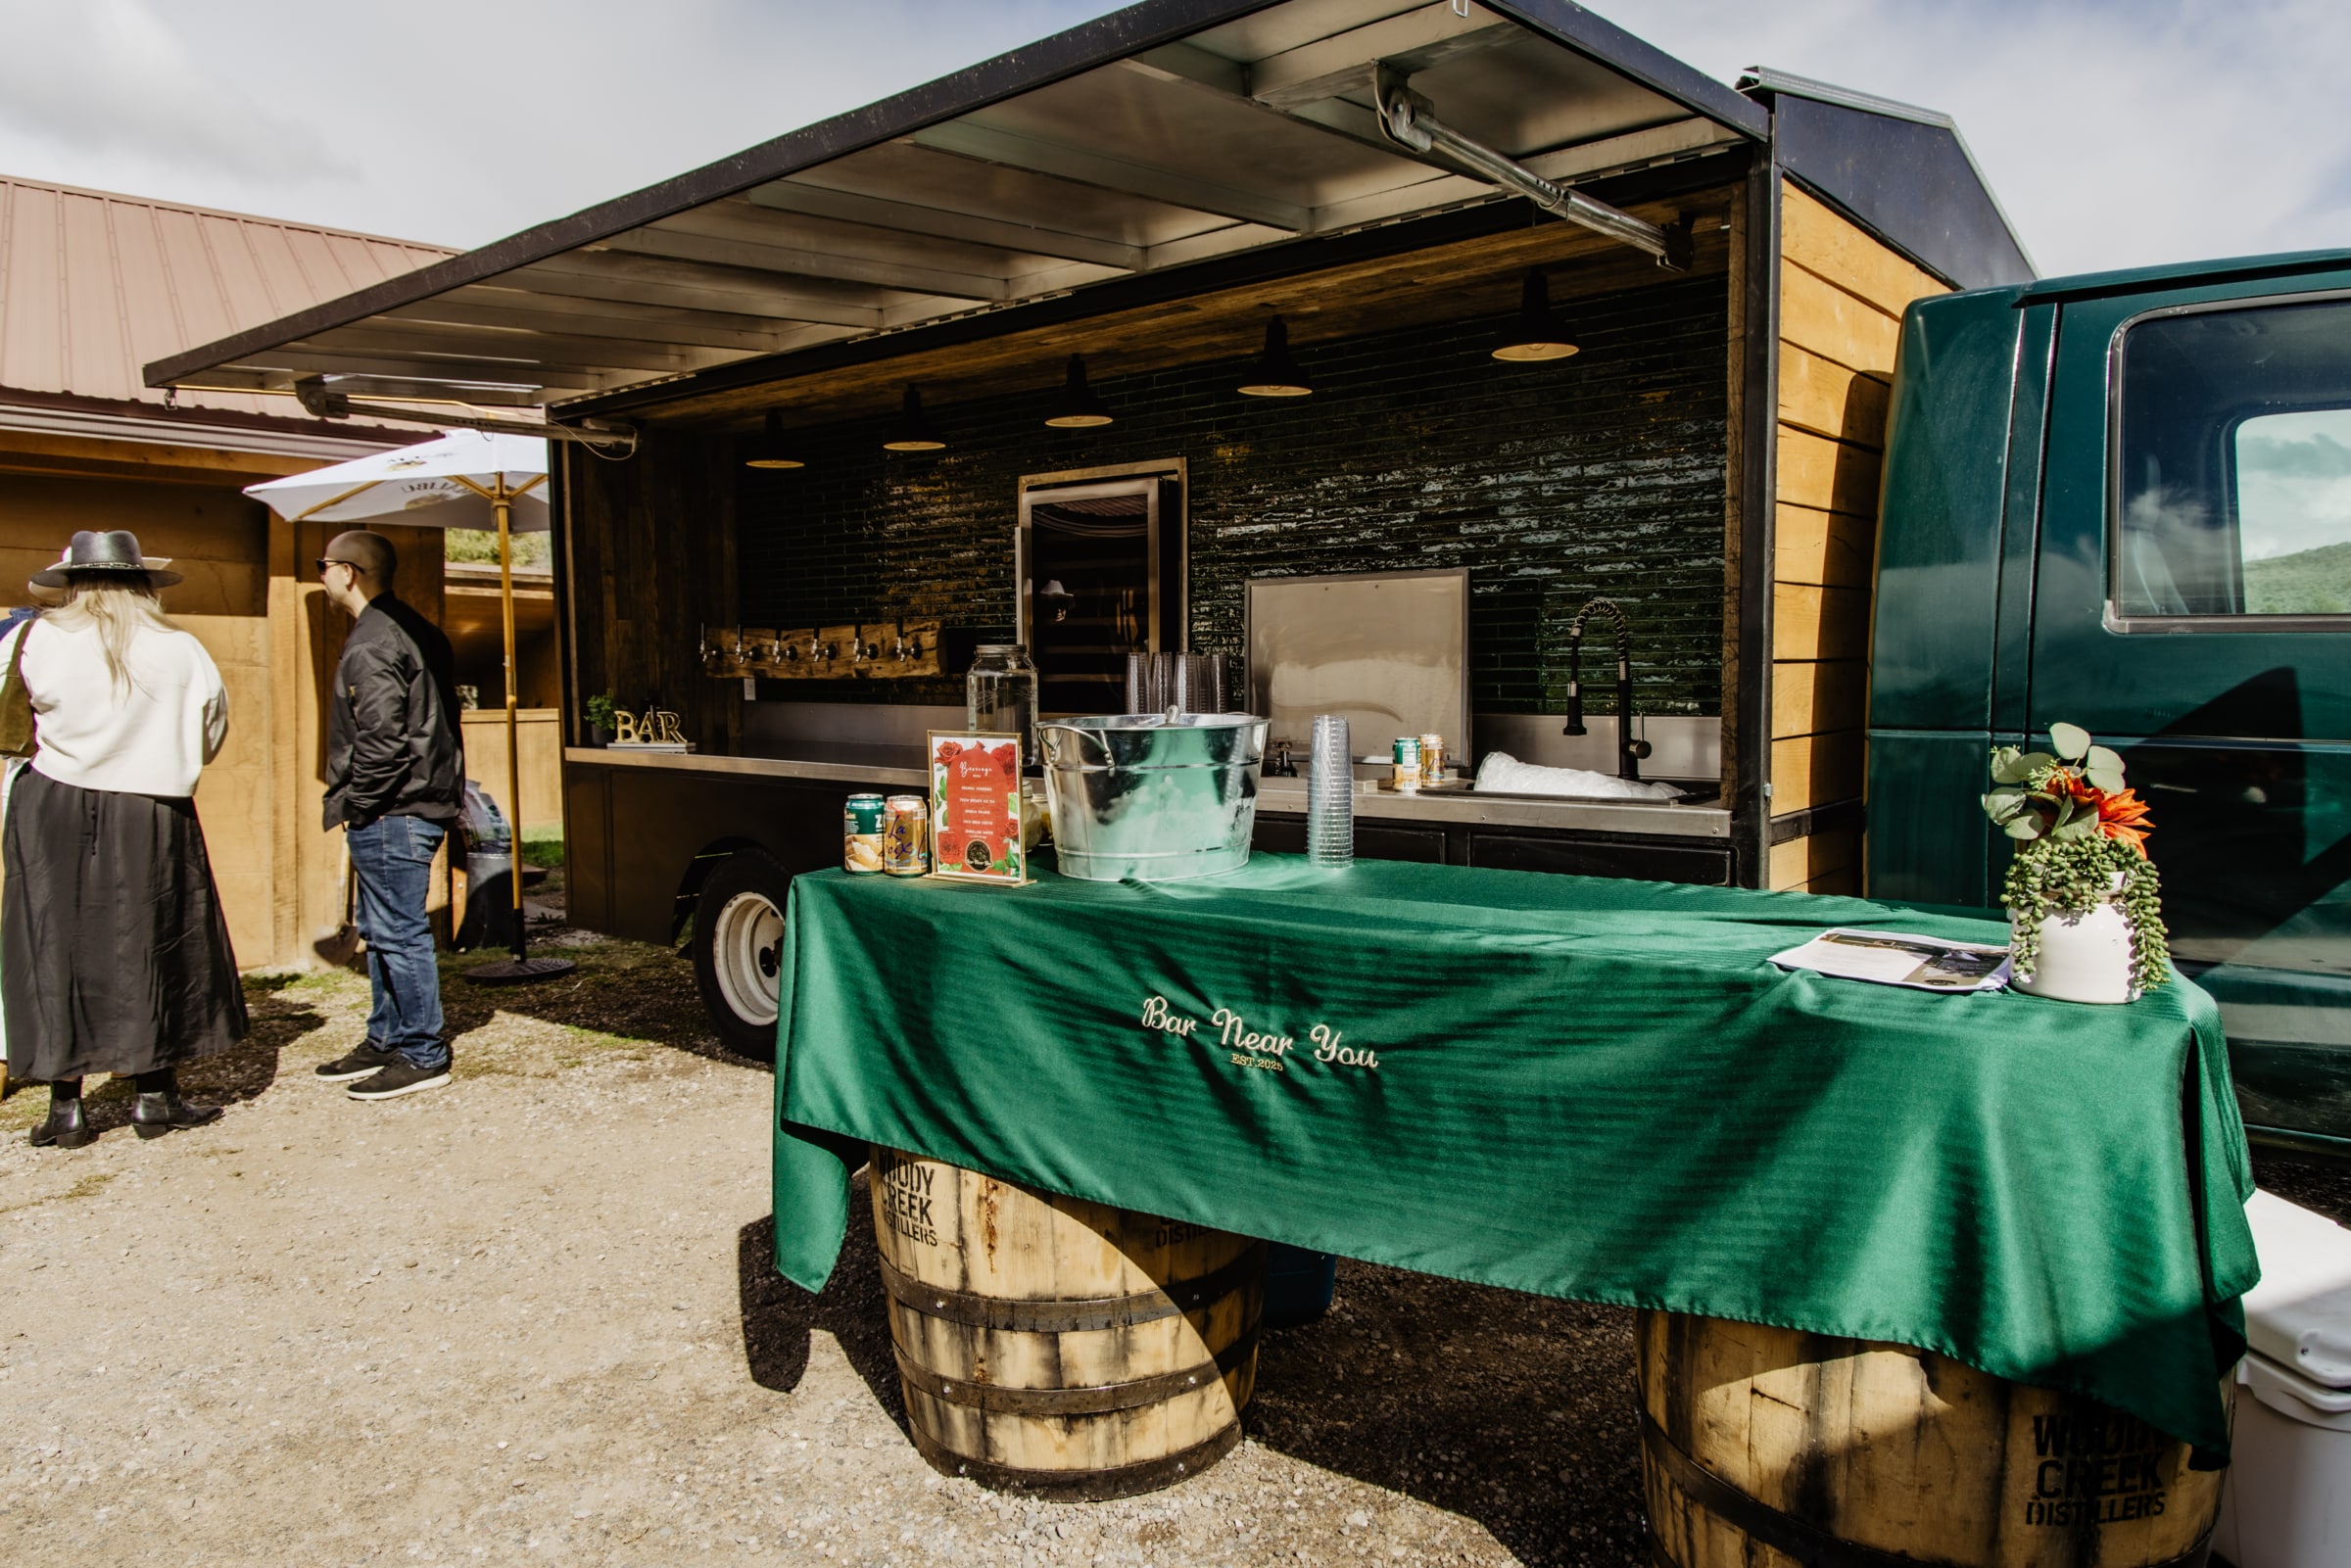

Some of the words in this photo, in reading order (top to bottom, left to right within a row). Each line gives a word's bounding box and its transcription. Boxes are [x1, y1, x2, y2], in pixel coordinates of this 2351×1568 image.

[613, 710, 688, 744] BAR
[888, 815, 906, 841] La
[1140, 995, 1197, 1036] Bar
[1211, 1008, 1294, 1057] Near
[1309, 1023, 1379, 1069] You
[1230, 1053, 1283, 1071] EST.2025
[2037, 1451, 2163, 1498] CREEK
[2026, 1492, 2166, 1526] DISTILLERS
